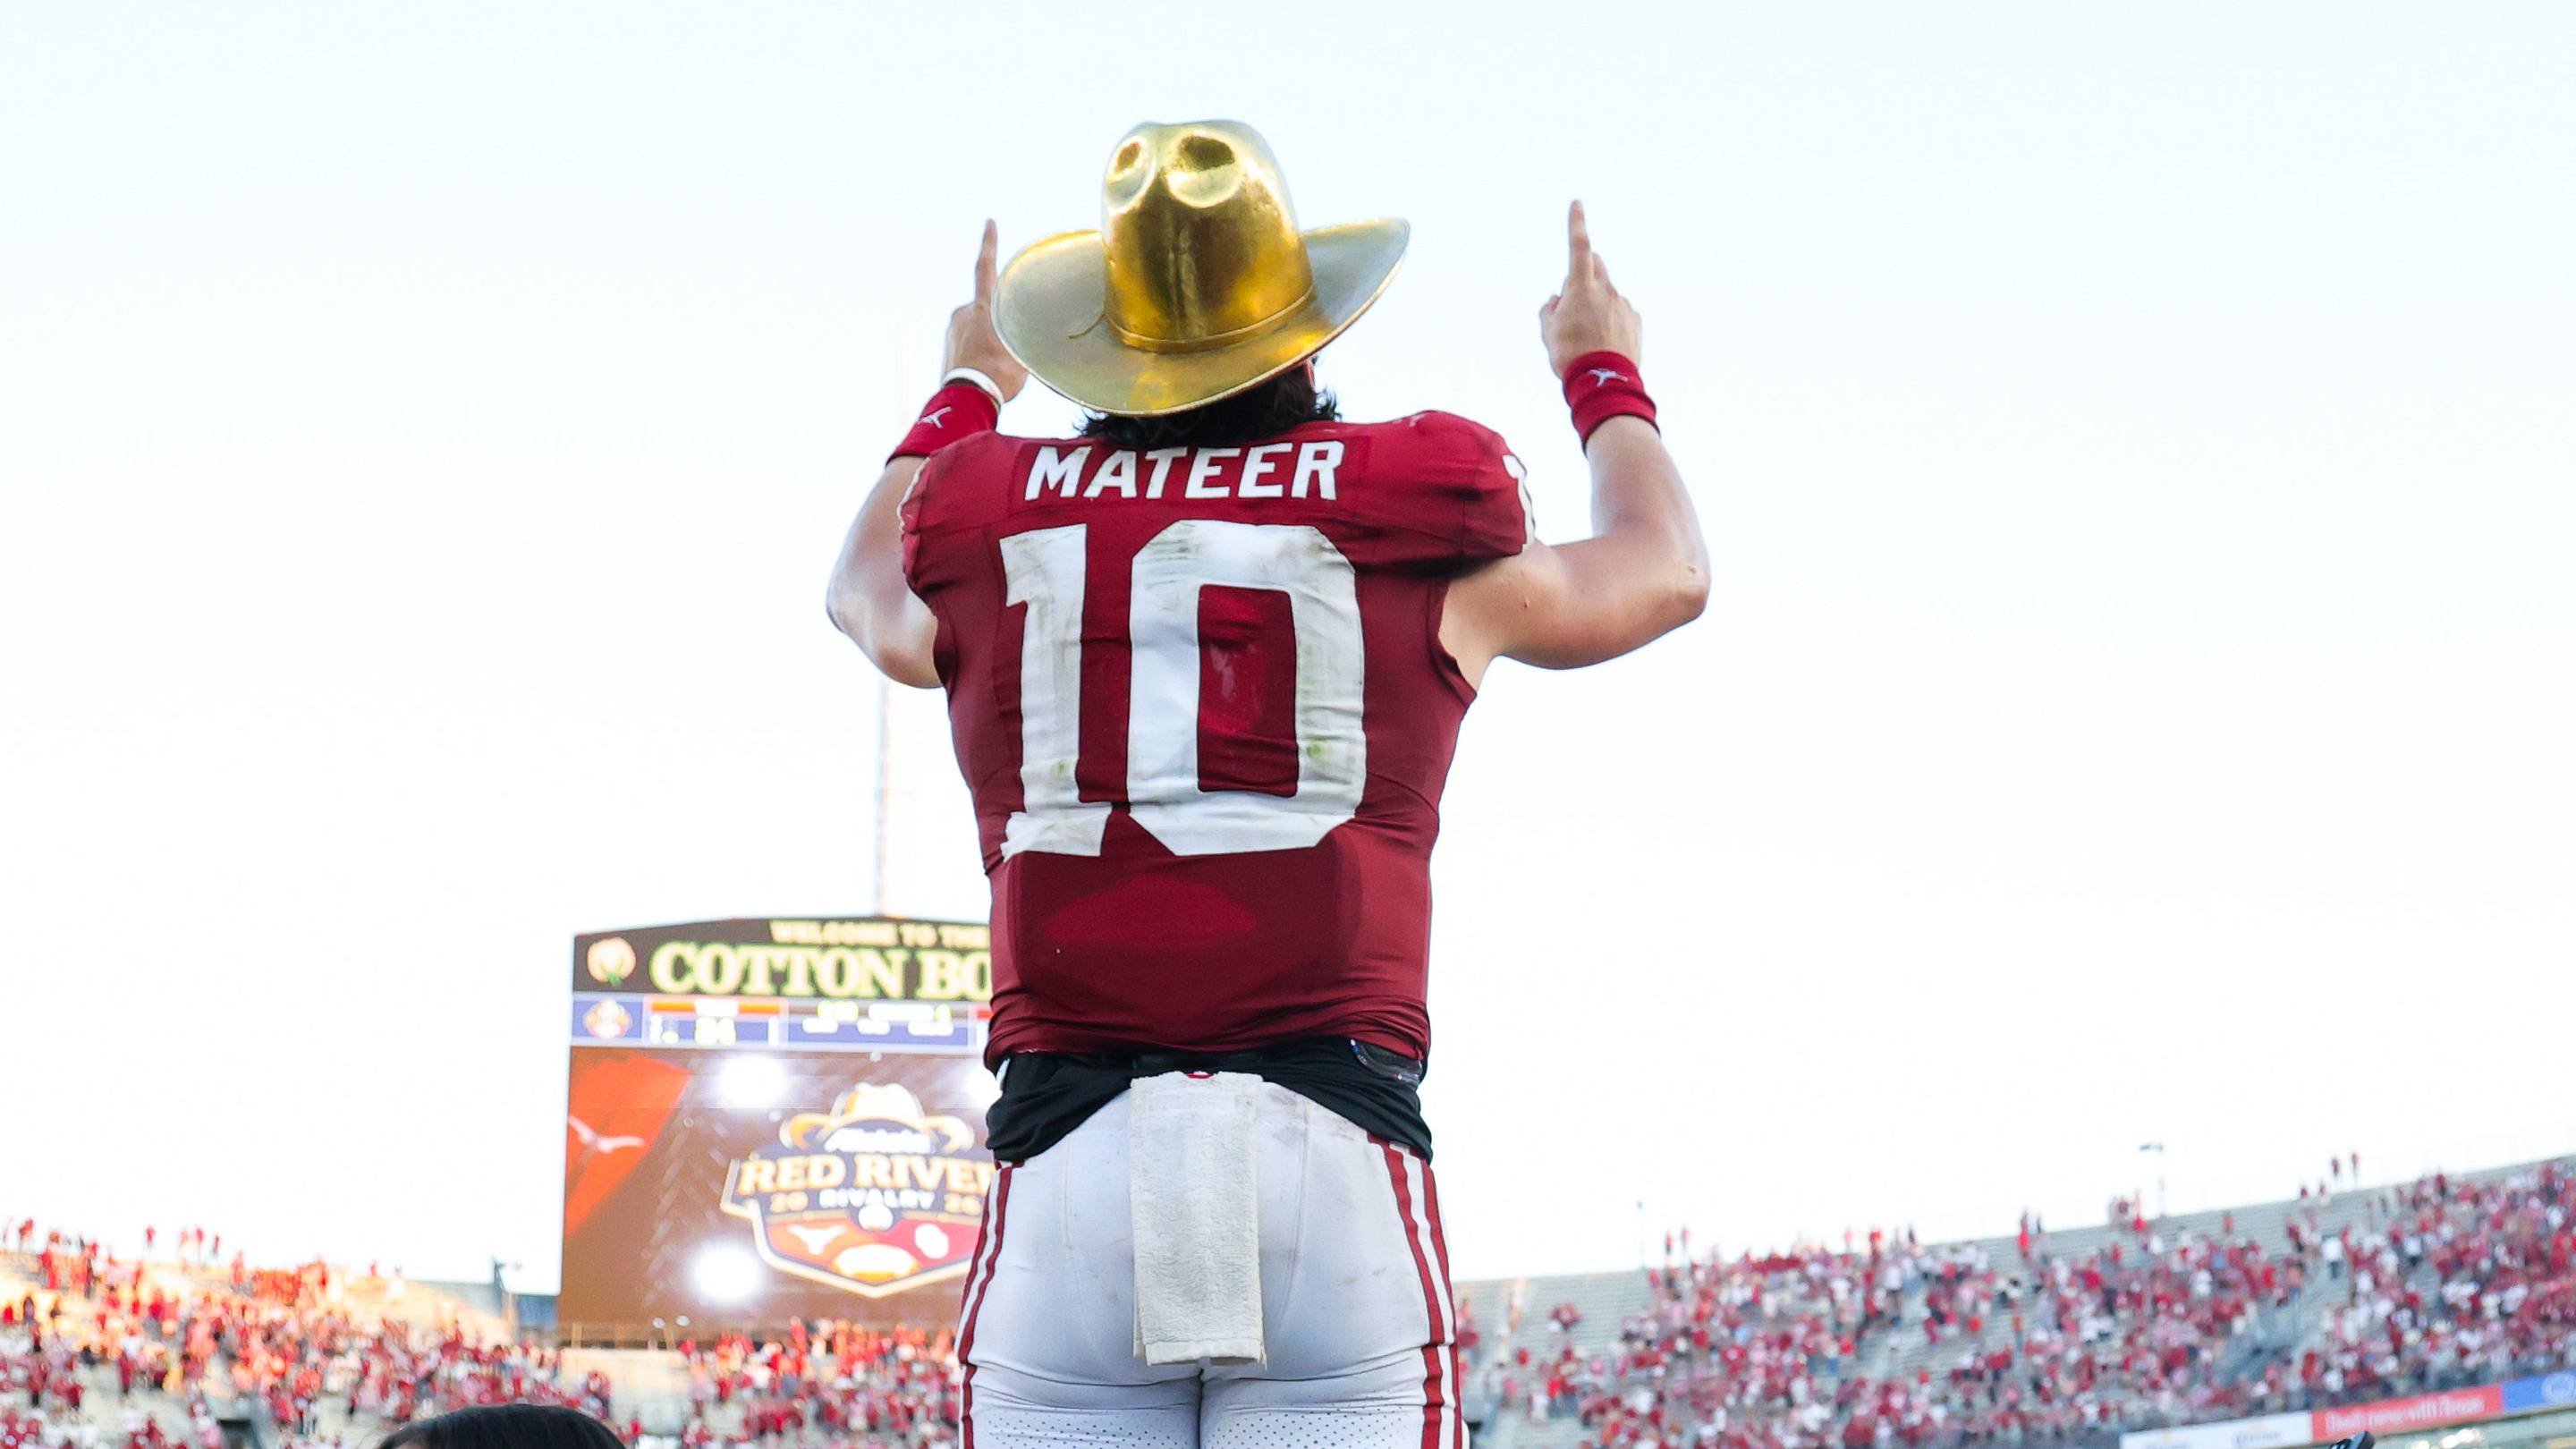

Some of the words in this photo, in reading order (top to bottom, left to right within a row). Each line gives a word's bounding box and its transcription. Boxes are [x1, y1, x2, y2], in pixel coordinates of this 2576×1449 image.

[1023, 439, 1344, 502] MATEER
[999, 519, 1368, 862] 10
[899, 922, 938, 948] TO
[649, 941, 911, 999] COTTON
[915, 947, 993, 1002] BO
[737, 1153, 847, 1196] RED
